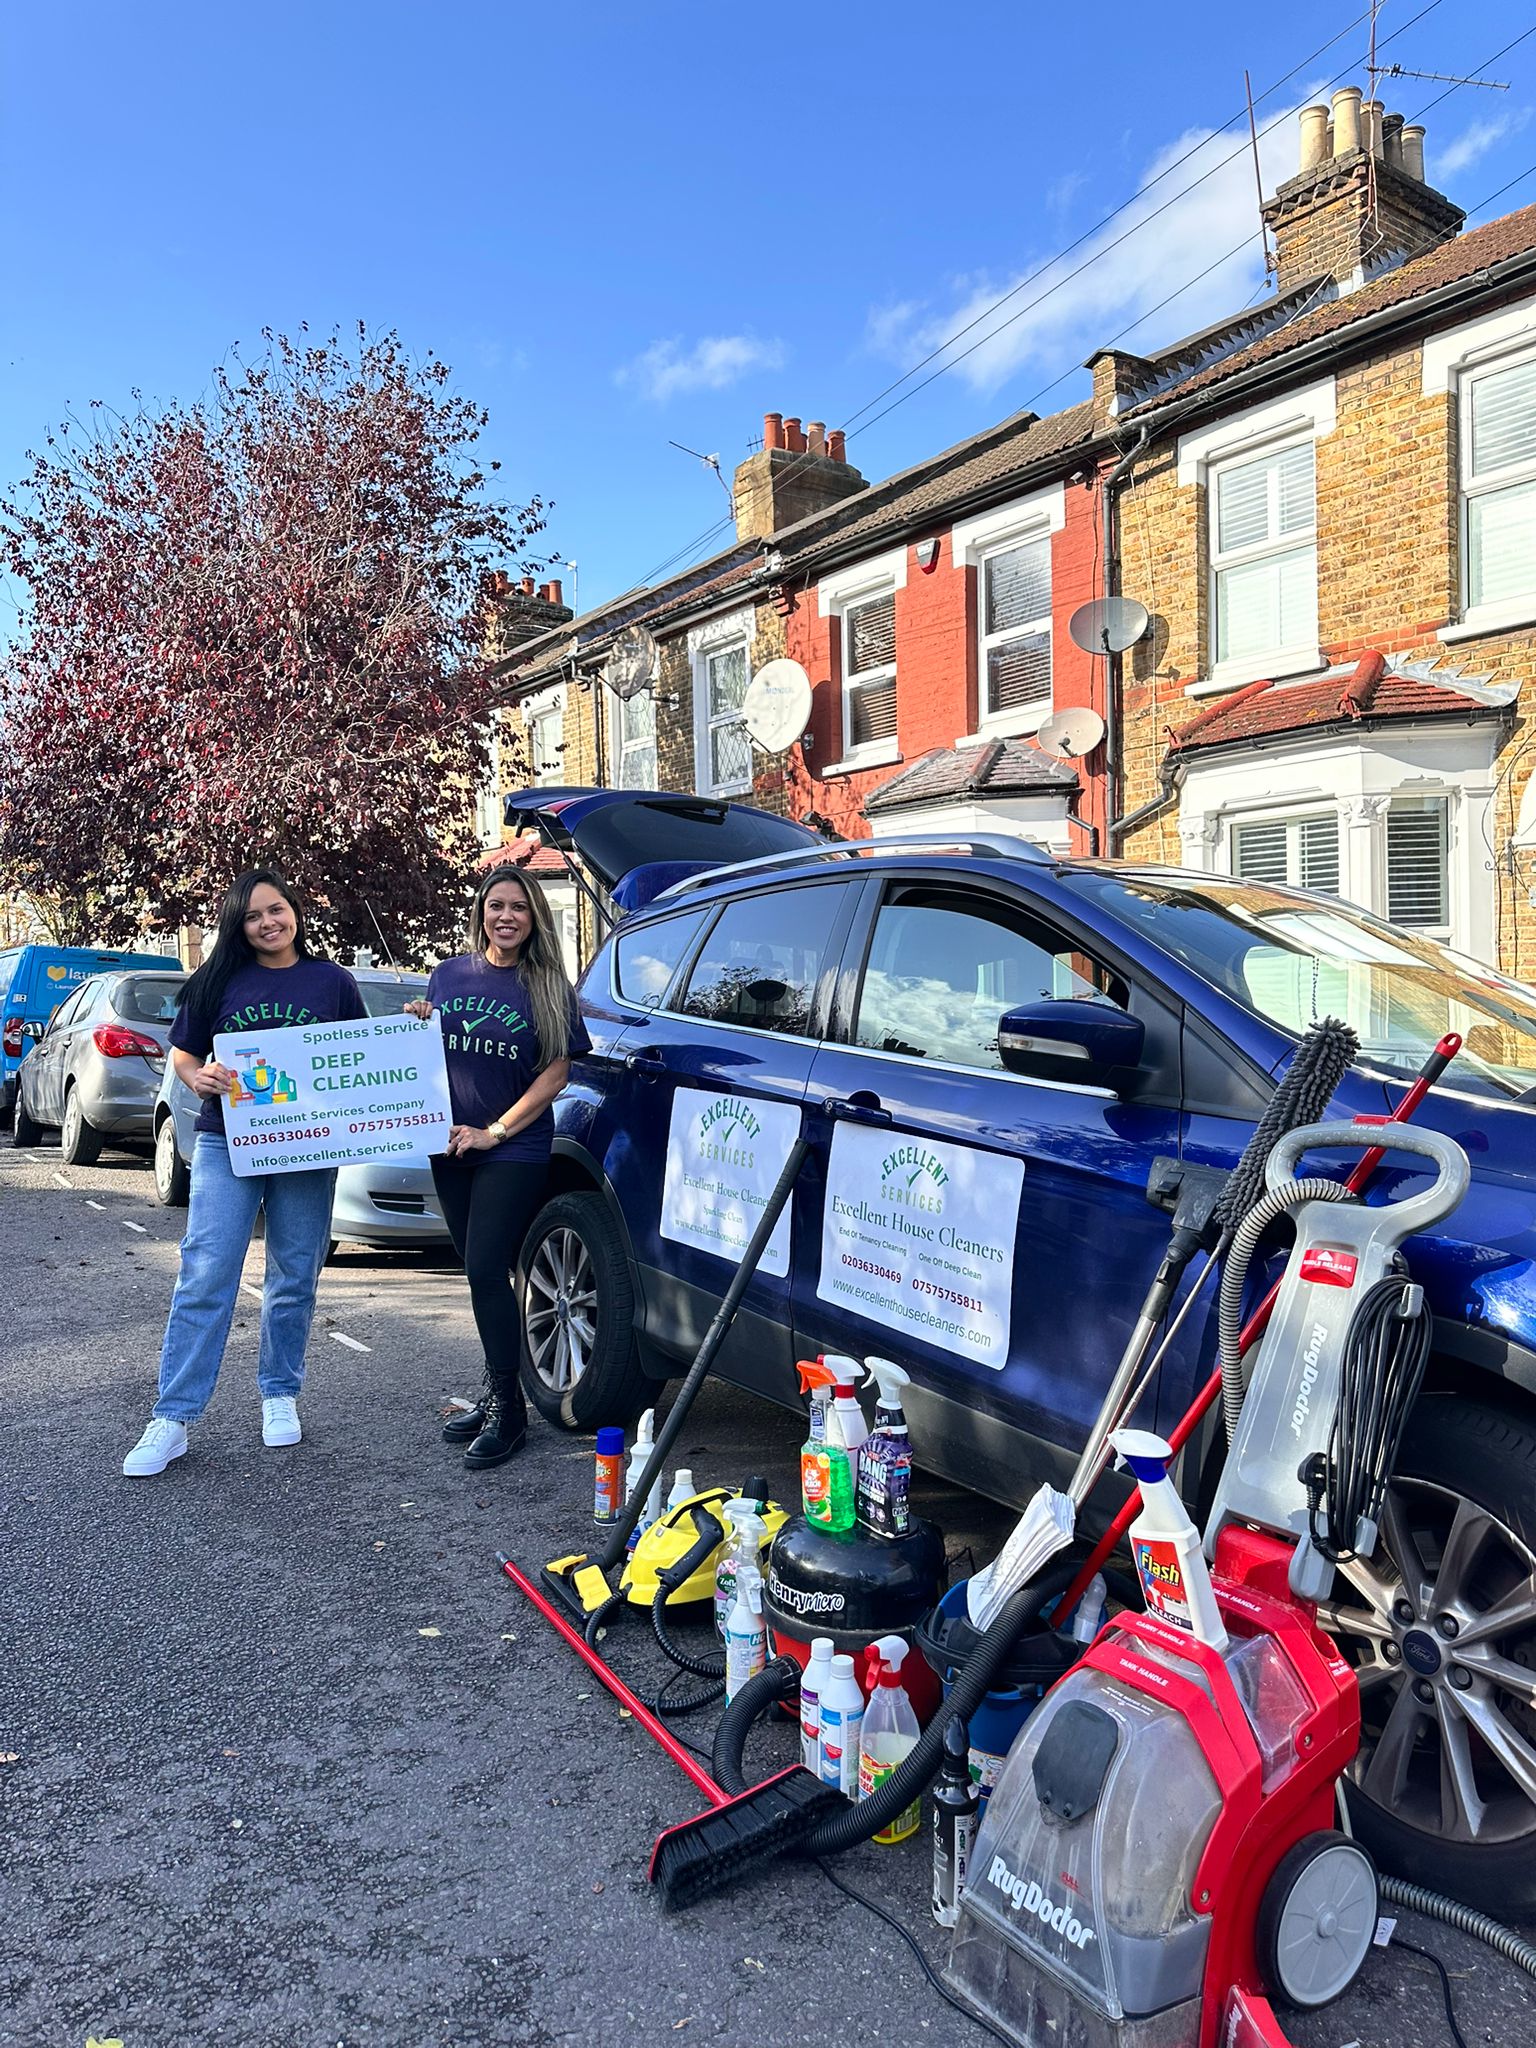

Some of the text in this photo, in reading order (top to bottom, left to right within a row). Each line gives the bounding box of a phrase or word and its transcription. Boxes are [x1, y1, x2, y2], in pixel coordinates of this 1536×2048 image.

[224, 1002, 319, 1033] EXCELLE
[441, 996, 528, 1034] XCELLENT
[303, 1021, 429, 1045] Spotless Service
[442, 1033, 519, 1060] RVICES
[311, 1051, 366, 1071] DEEP
[313, 1066, 418, 1092] CLEANING
[249, 1099, 425, 1127] Excellent Services Company
[701, 1098, 761, 1140] EXCELLENT
[232, 1111, 446, 1147] 02036330469 07575755811
[251, 1141, 414, 1168] info@excellent.services
[700, 1142, 755, 1169] SERVICES
[881, 1146, 950, 1187] EXCELLENT
[683, 1173, 770, 1208] Excellent House Cleane
[880, 1184, 943, 1215] SERVICES
[674, 1219, 778, 1258] www.excellenthousecleancom
[832, 1195, 1004, 1264] Excellent House Cleaners
[839, 1226, 907, 1257] End Of Tenancy Cleaning
[918, 1252, 982, 1280] One Off Deep Clean
[841, 1253, 983, 1313] 02036330469 07575755811
[832, 1277, 992, 1348] www.excellenthousecleaners.com
[1290, 1322, 1328, 1438] RugDoctor
[858, 1449, 888, 1487] BANG
[1141, 1551, 1181, 1584] Flash
[1150, 1603, 1182, 1626] BLEACH
[1230, 1596, 1262, 1613] HANDLE
[1135, 1620, 1186, 1646] CARRY HANDLE
[1410, 1646, 1431, 1661] Ford
[1119, 1658, 1169, 1687] TANK HANDLE
[987, 1855, 1096, 1950] RugDoctor
